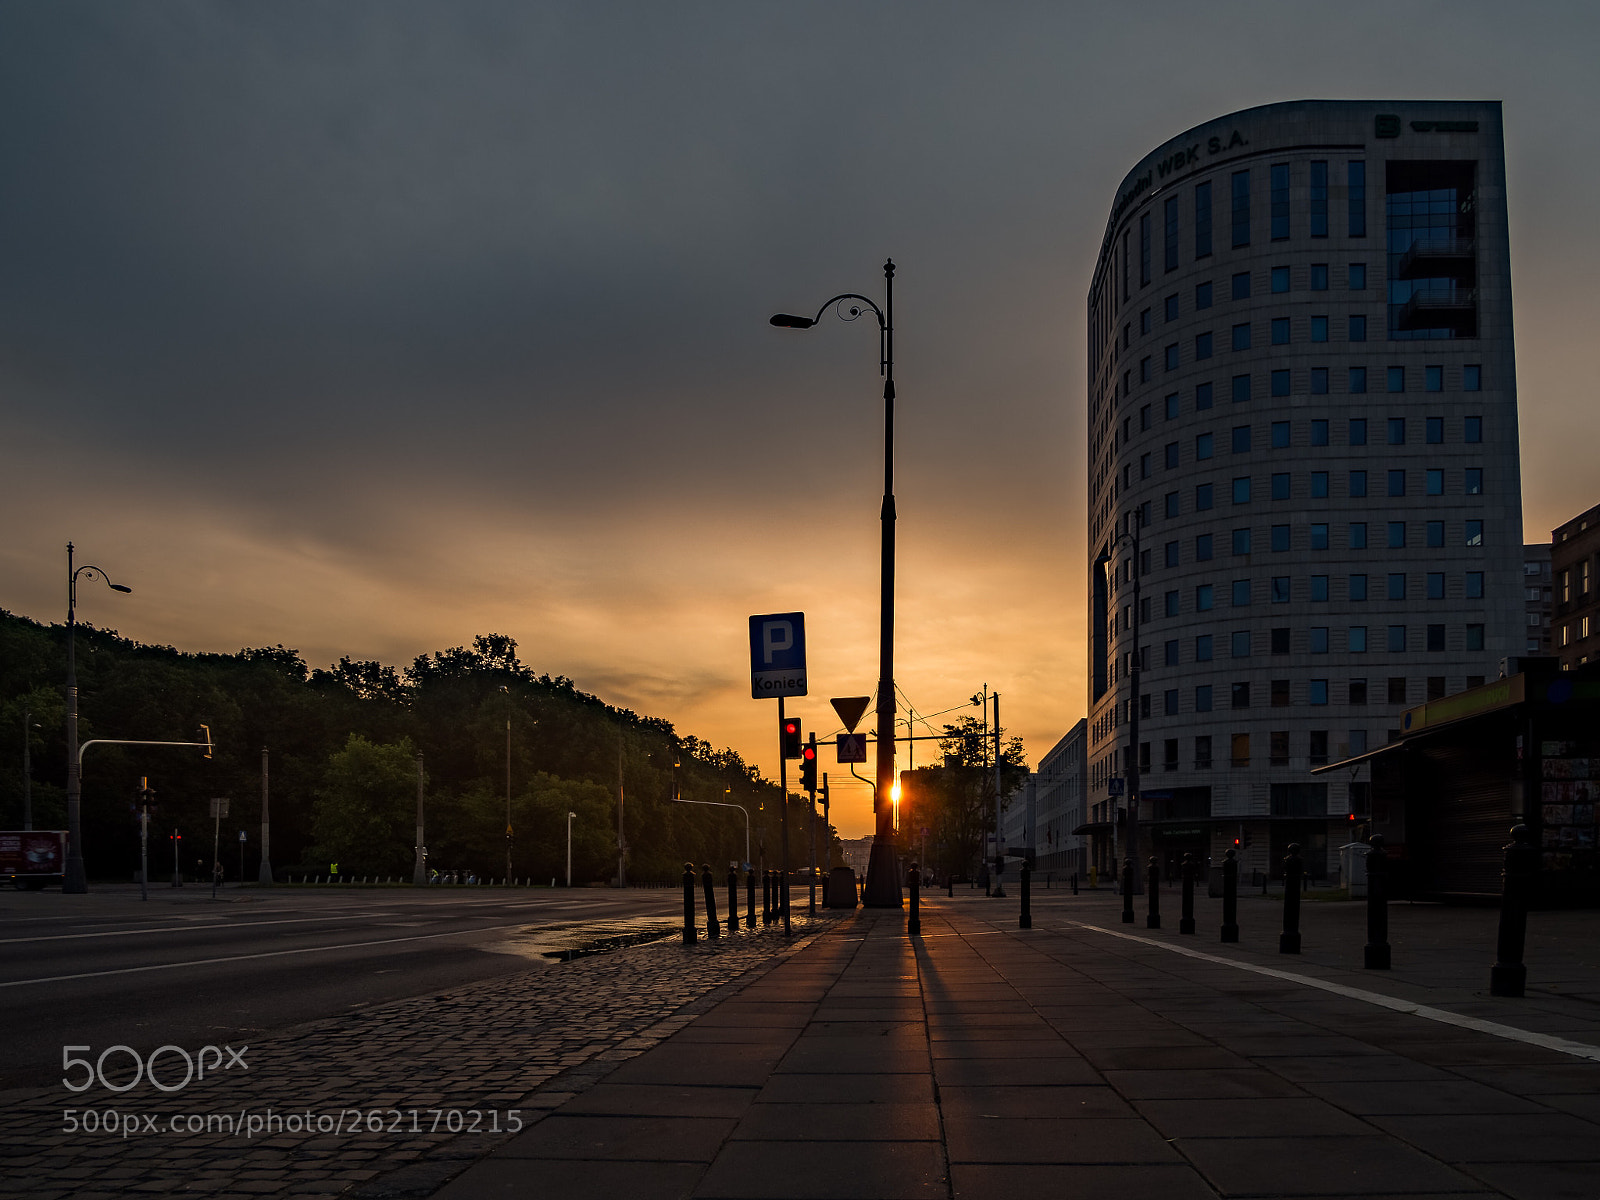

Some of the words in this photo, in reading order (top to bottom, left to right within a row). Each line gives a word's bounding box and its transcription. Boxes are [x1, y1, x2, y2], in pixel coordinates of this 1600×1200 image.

[1157, 143, 1199, 179] WBK
[1207, 129, 1250, 156] S.A.
[762, 619, 793, 665] P
[754, 676, 804, 691] Koniec
